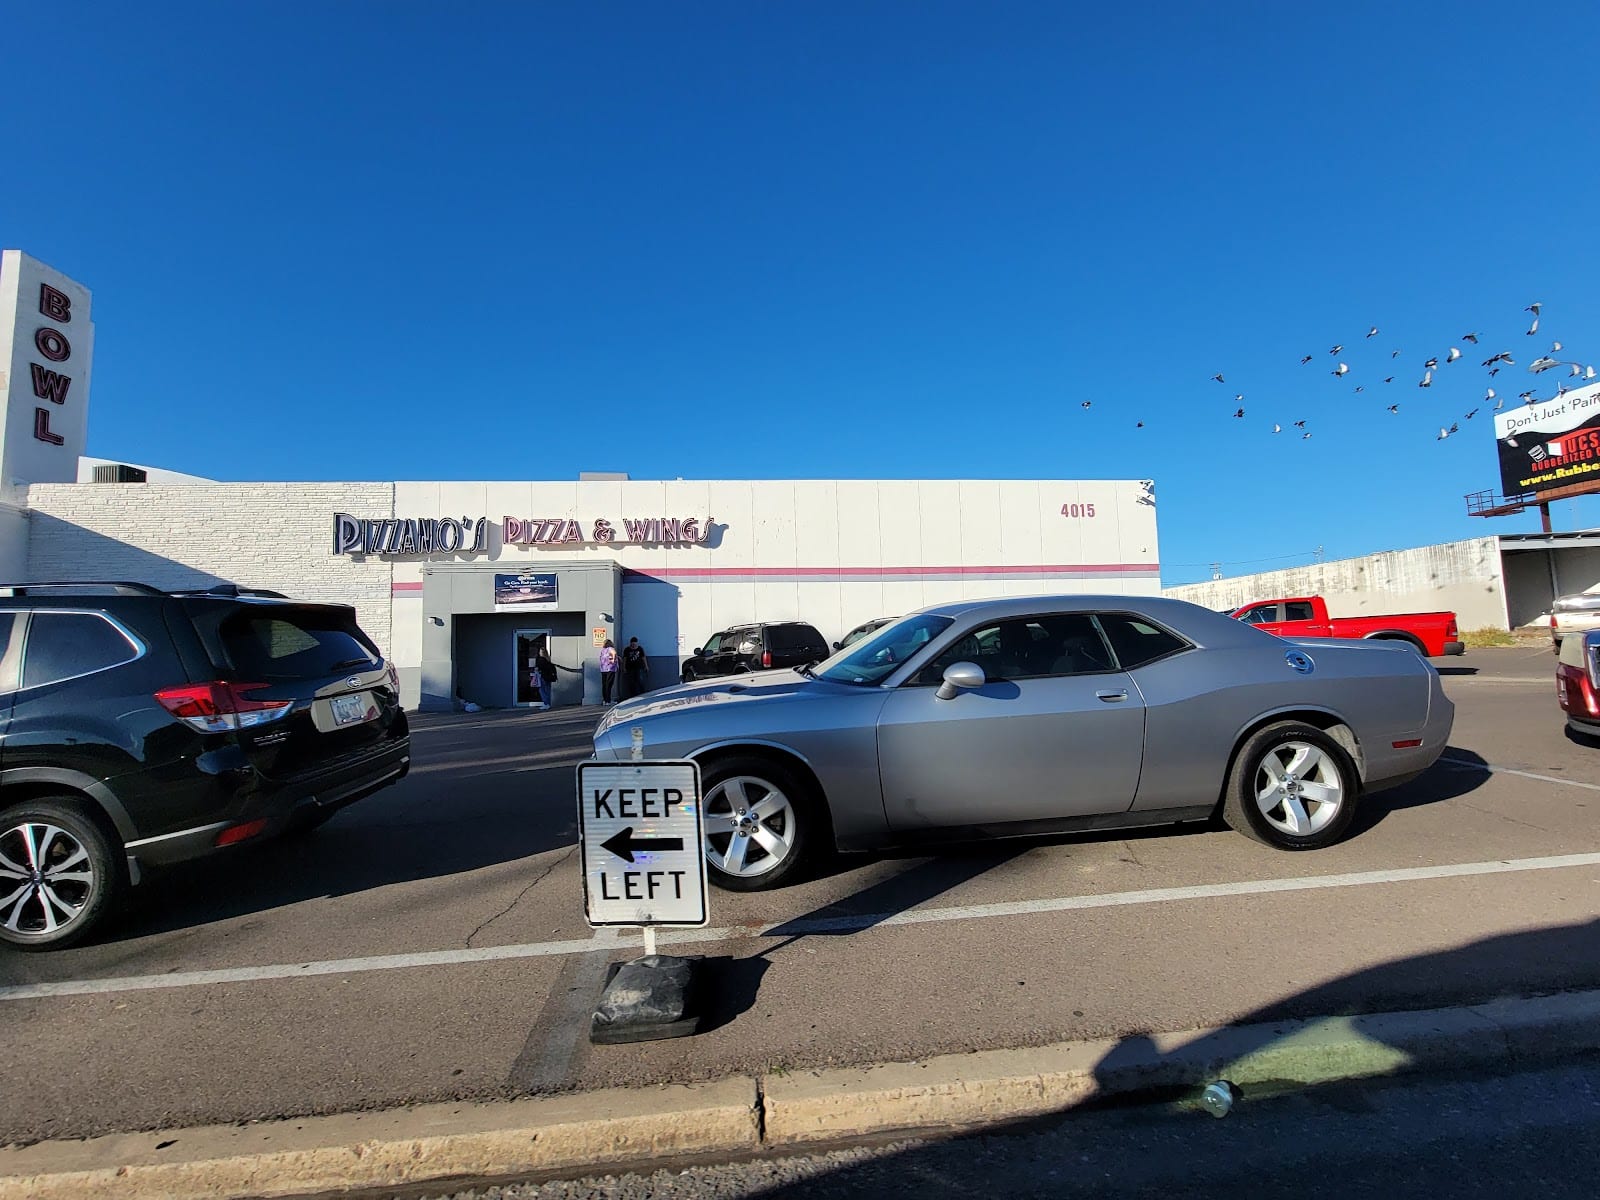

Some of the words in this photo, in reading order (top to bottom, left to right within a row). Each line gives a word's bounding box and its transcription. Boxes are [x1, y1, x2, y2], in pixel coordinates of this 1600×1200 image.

[31, 283, 71, 446] BOWL
[1506, 412, 1539, 430] Don't
[1541, 404, 1566, 420] Just
[1531, 449, 1593, 472] RUBBERIZED
[1519, 462, 1600, 487] www.Rubbe
[1060, 503, 1096, 518] 4015
[333, 512, 487, 555] PIZZANO'S
[503, 515, 583, 544] PIZZA
[592, 518, 612, 543] &
[622, 517, 714, 543] WINGS
[594, 788, 683, 819] KEEP
[600, 871, 686, 900] LEFT
